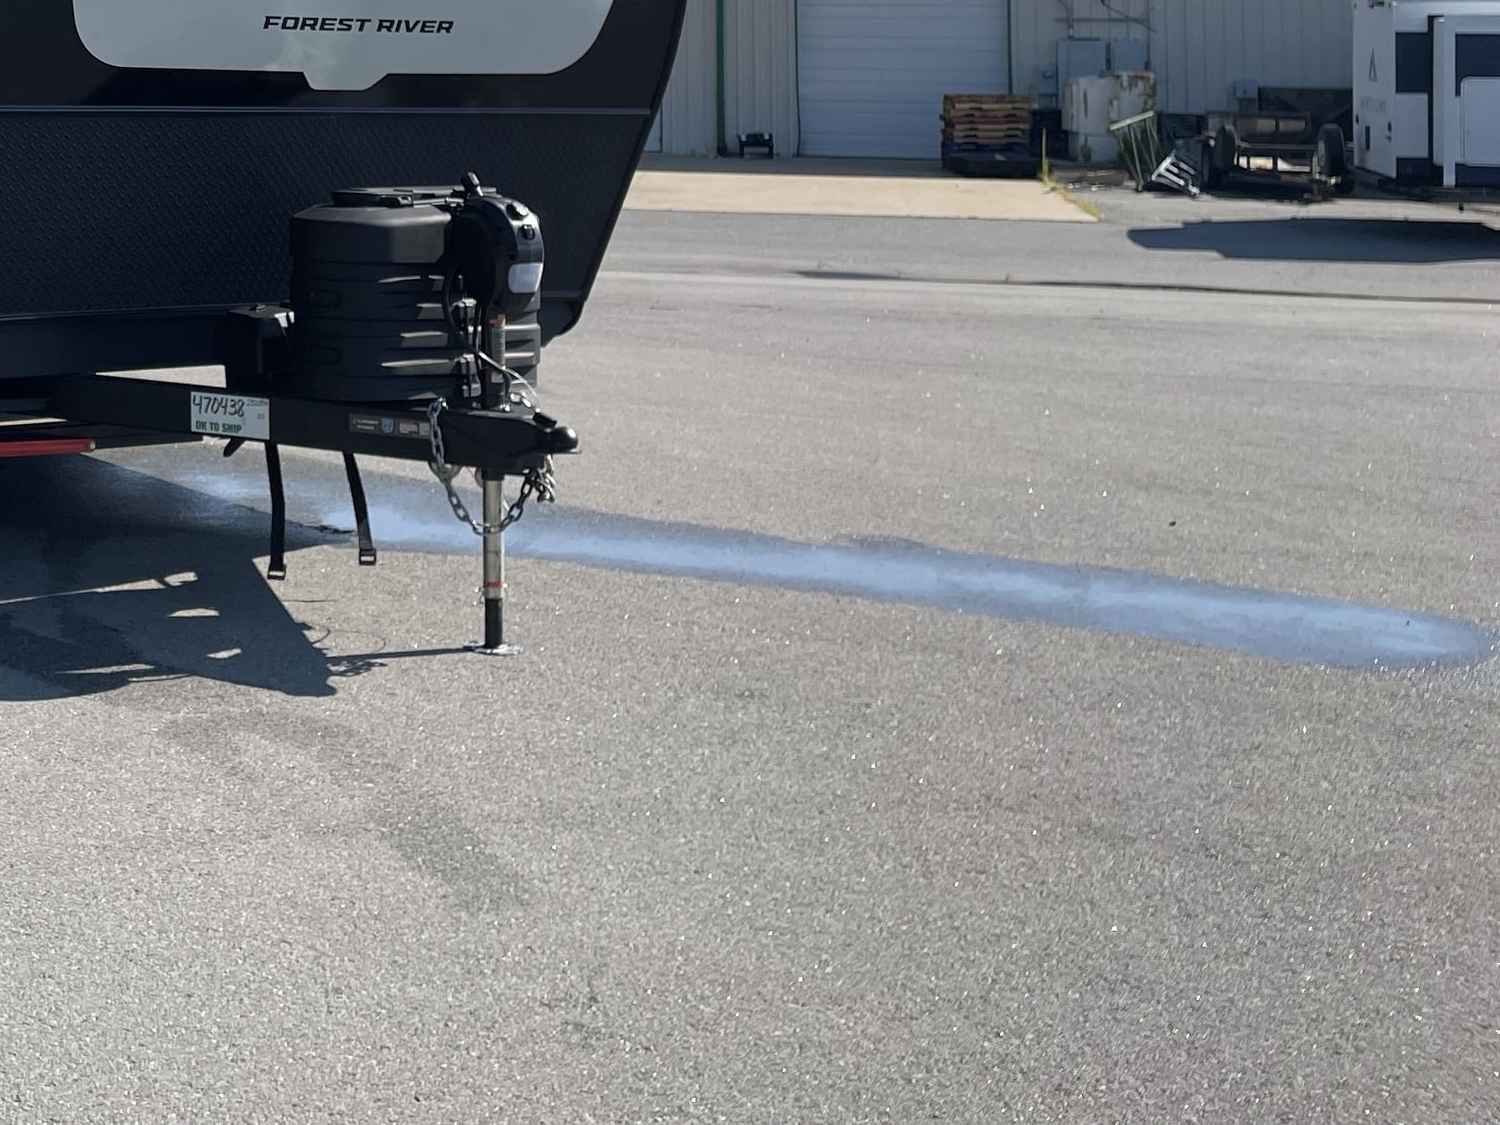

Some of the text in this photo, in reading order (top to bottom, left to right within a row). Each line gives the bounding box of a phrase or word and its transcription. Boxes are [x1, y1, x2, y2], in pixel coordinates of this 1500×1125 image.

[263, 15, 454, 34] FOREST RIVER
[195, 420, 242, 433] OK TO SHIP
